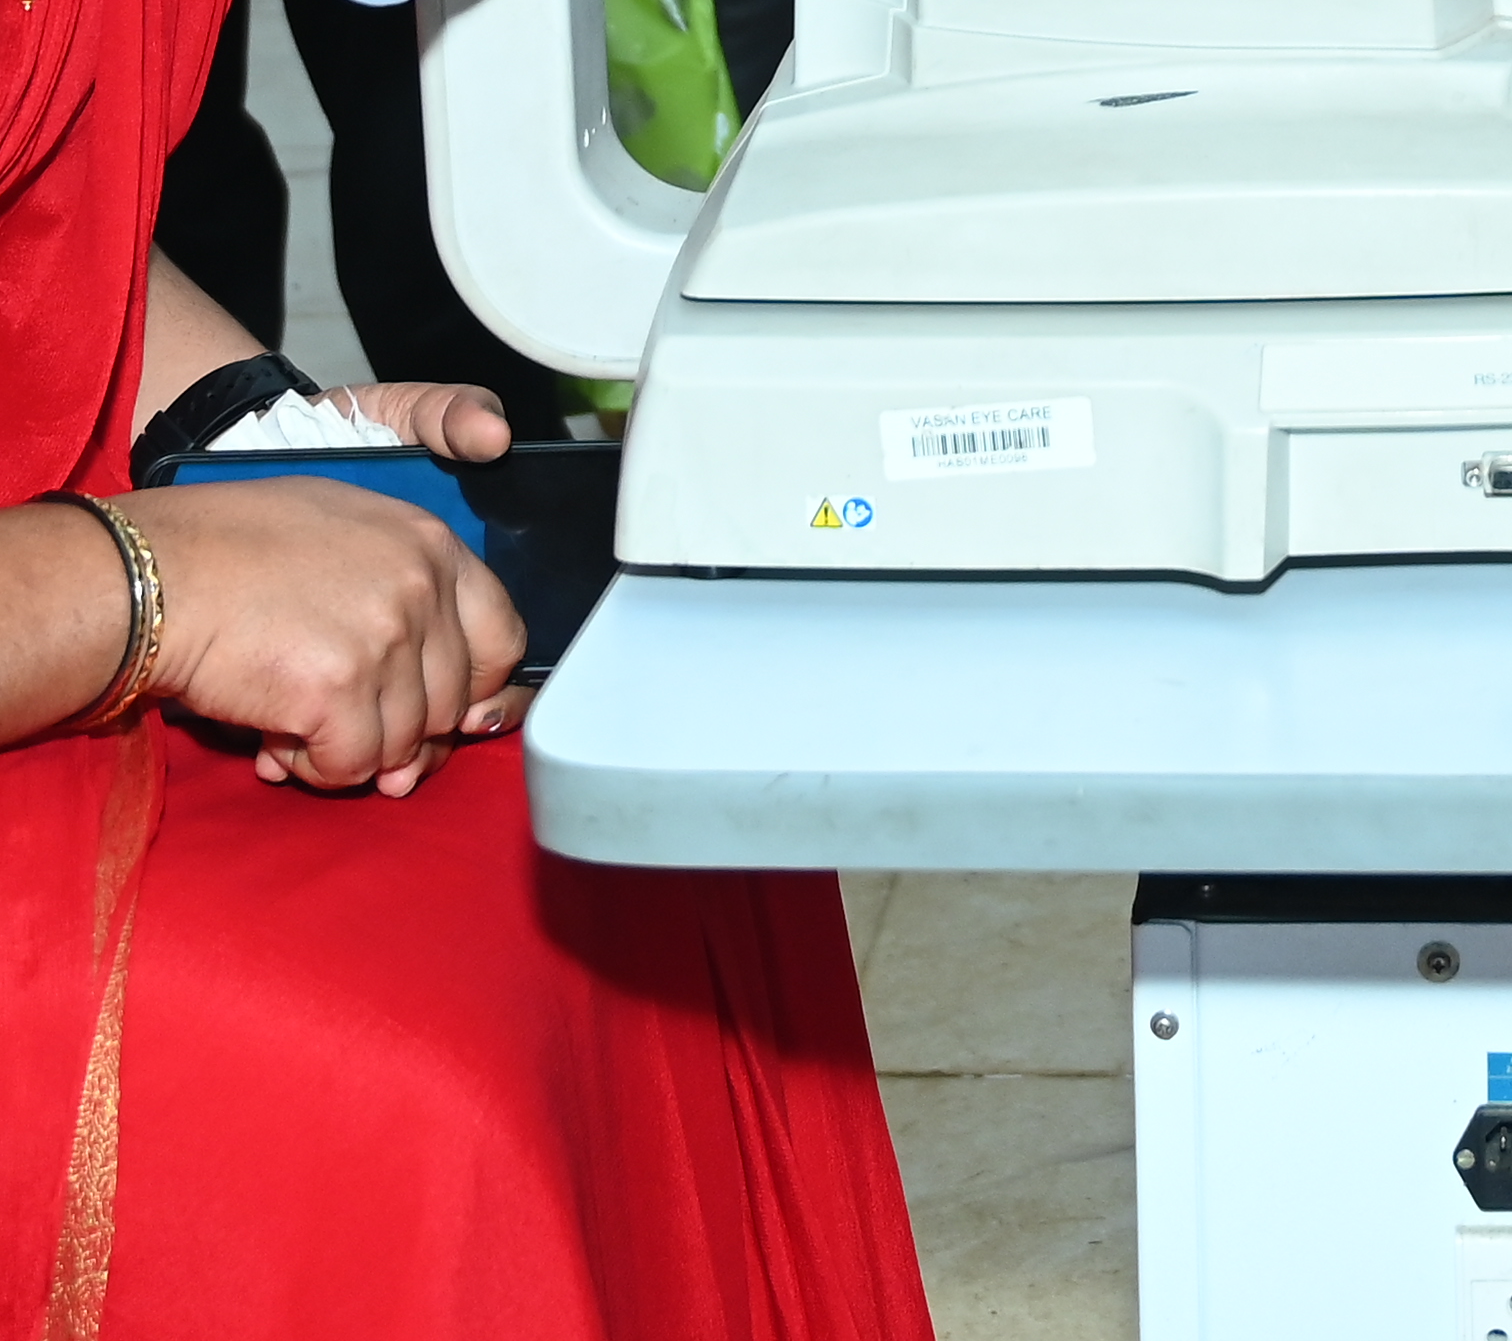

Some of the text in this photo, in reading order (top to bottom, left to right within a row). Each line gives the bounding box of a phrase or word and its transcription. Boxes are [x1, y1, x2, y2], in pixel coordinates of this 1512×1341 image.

[911, 406, 1052, 428] VASAN EYE CARE
